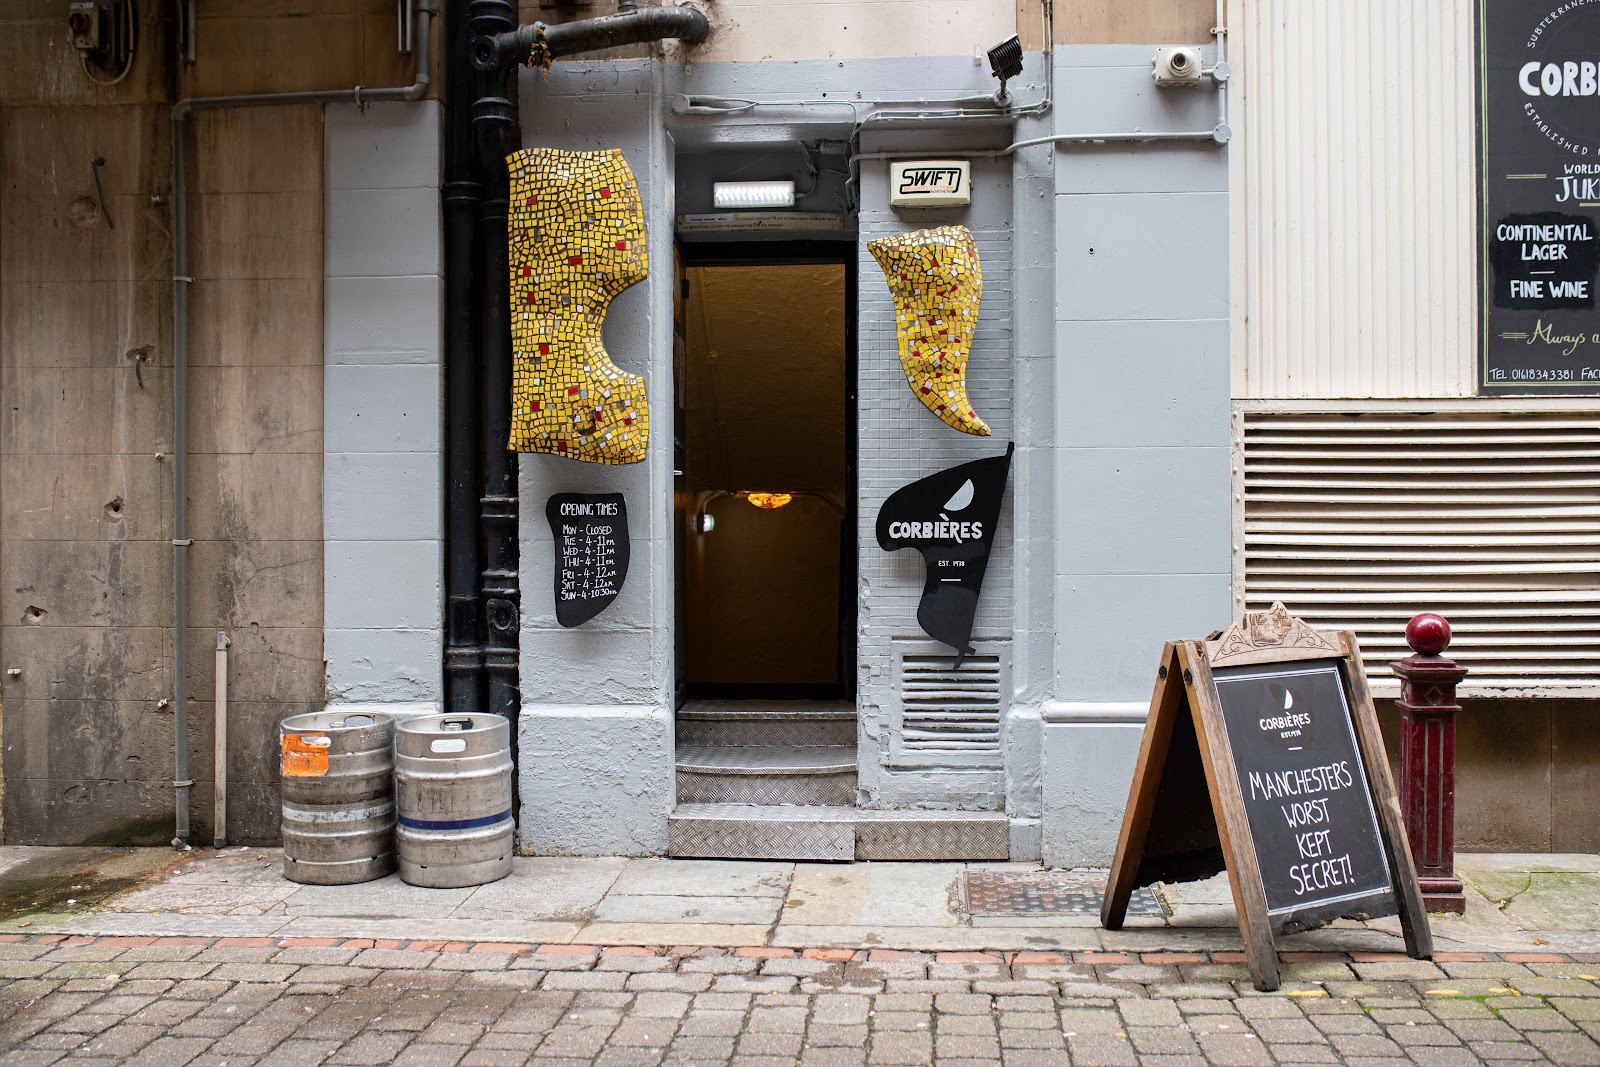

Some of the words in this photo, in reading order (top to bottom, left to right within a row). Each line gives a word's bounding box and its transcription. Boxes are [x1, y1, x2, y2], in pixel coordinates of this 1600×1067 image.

[1524, 102, 1588, 155] ESTABLISHED
[901, 167, 961, 189] SWIFT
[1555, 176, 1600, 202] JUK
[1497, 224, 1593, 242] CONTINENTAL
[1521, 243, 1568, 261] LAGER
[1510, 280, 1544, 299] FINE
[1549, 280, 1589, 299] WINE
[1527, 319, 1586, 356] Always
[1581, 366, 1600, 380] FAC
[560, 503, 593, 516] OPENING
[595, 502, 618, 516] TIMES
[562, 523, 578, 535] MON
[585, 523, 613, 536] CLOSED
[888, 512, 983, 544] CORBIÈRES
[563, 535, 577, 546] TUE
[562, 546, 579, 556] WED
[562, 555, 580, 568] THU
[562, 568, 575, 580] FRI
[561, 578, 576, 590] SAT
[560, 589, 577, 601] SUN
[1259, 711, 1311, 731] CORBIÈRES
[1248, 760, 1353, 801] MANCHESTERS
[1281, 797, 1331, 828] WORST
[1295, 829, 1332, 859] KEPT
[1289, 853, 1356, 896] SECRET!
